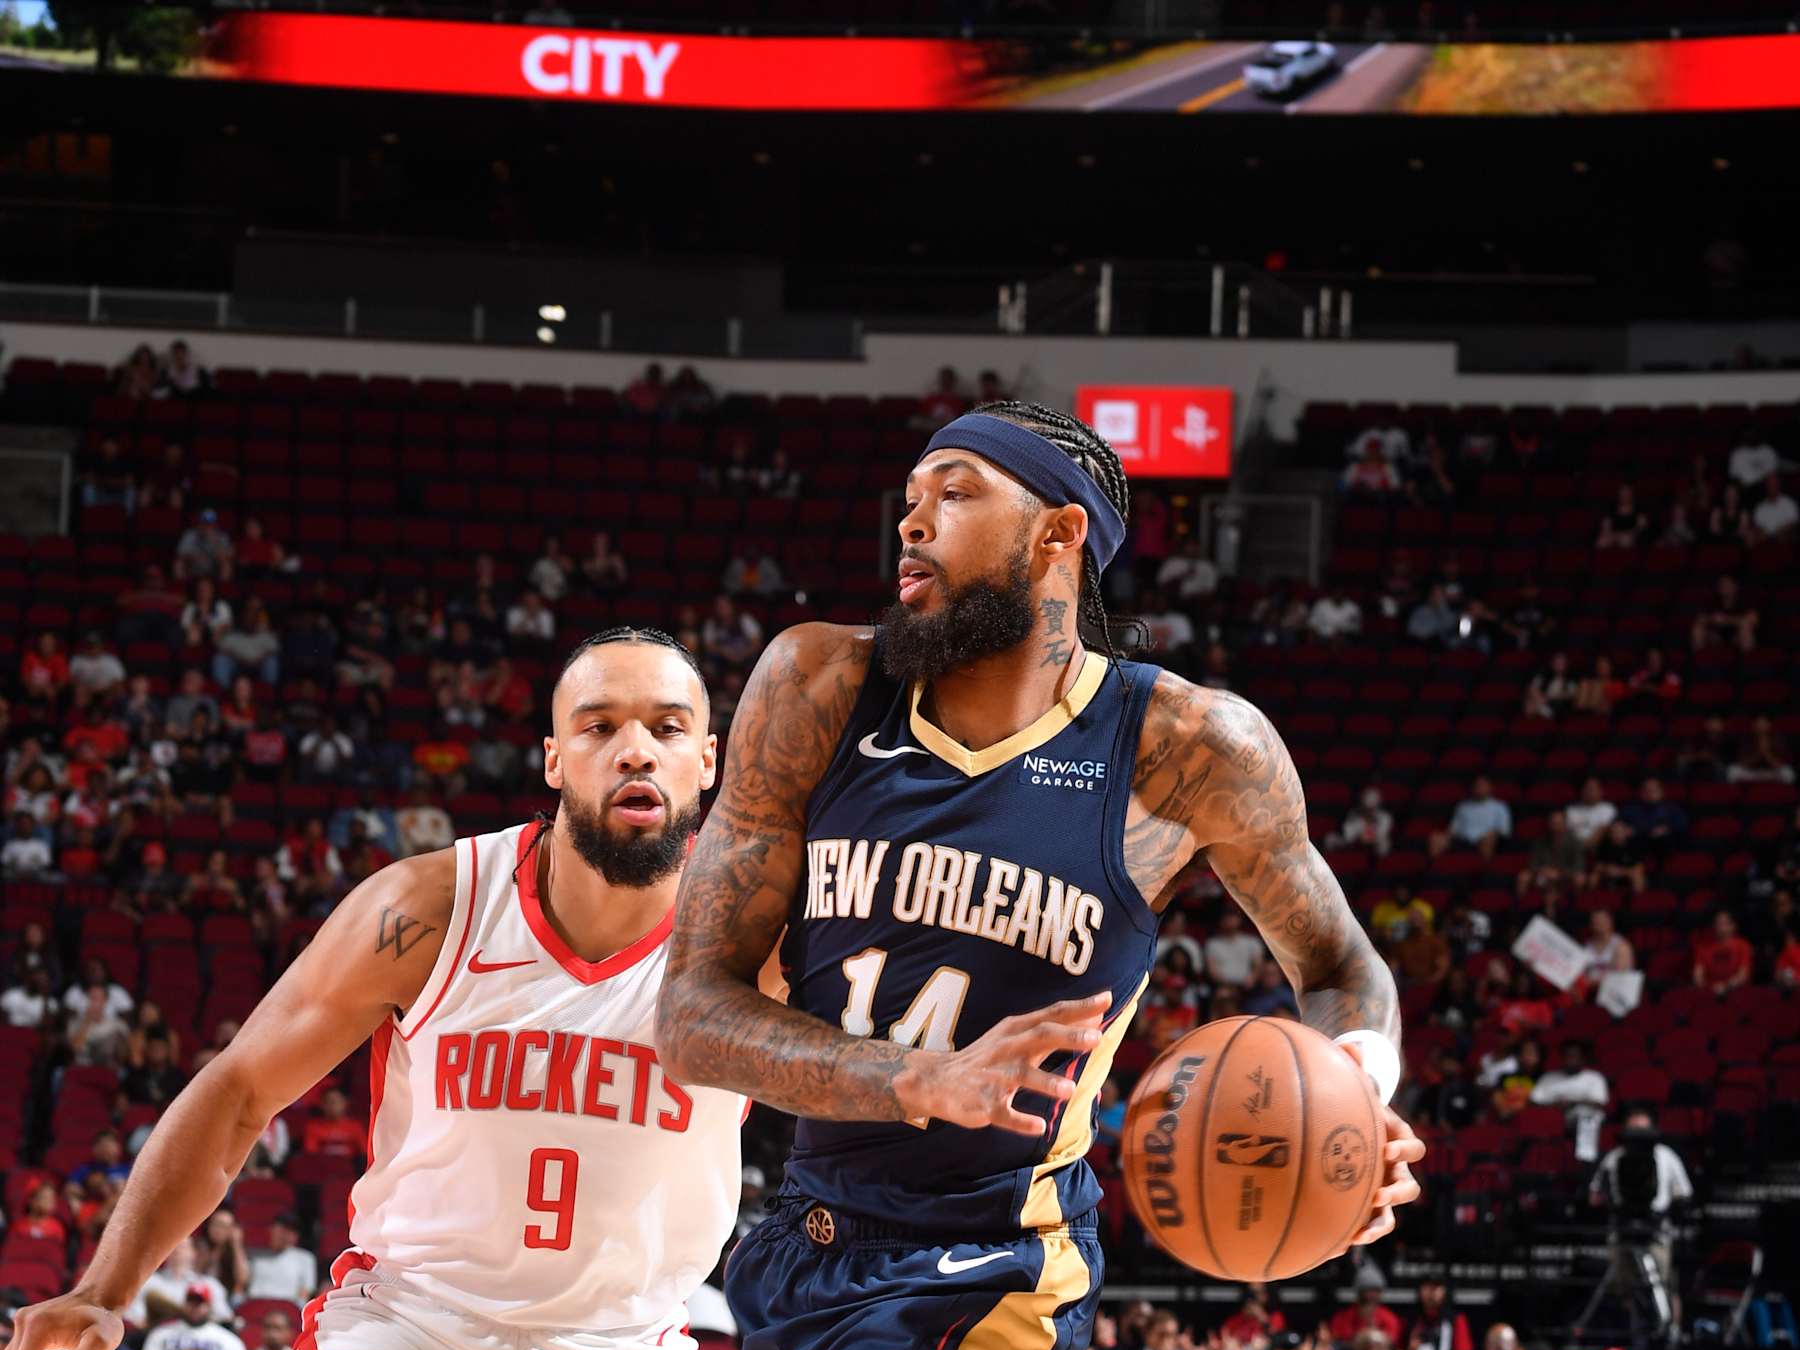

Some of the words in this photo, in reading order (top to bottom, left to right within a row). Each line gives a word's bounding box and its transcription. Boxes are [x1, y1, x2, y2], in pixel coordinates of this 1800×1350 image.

[521, 34, 680, 98] CITY
[1023, 753, 1106, 779] NEWAGE
[1031, 775, 1094, 791] GARAGE
[804, 839, 890, 920] NEW
[893, 841, 1104, 977] ORLEANS
[434, 1029, 695, 1133] ROCKETS
[1144, 1055, 1207, 1229] Wilson
[523, 1147, 580, 1252] 9
